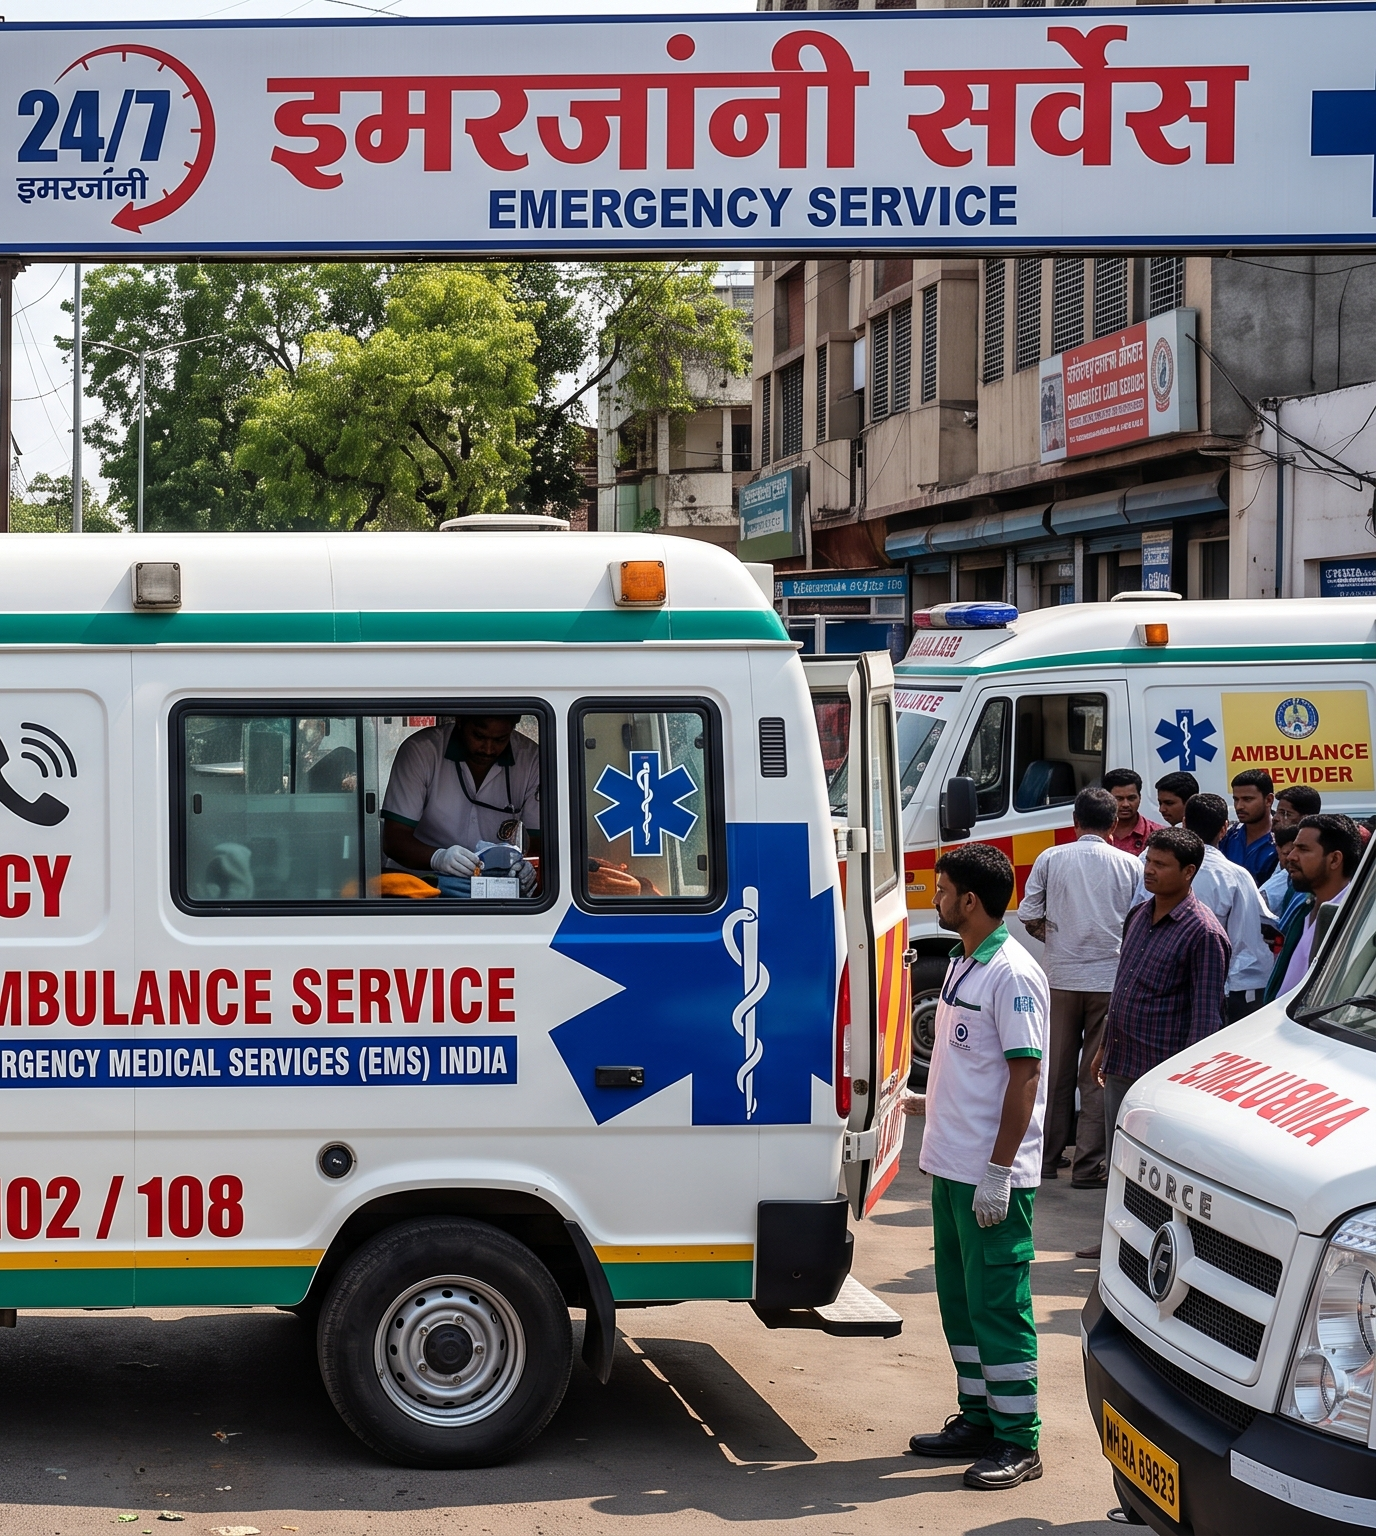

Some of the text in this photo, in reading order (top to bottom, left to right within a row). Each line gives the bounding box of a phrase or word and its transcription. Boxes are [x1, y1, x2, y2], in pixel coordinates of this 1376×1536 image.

[17, 88, 170, 163] 24/7
[489, 185, 1017, 230] EMERGENCY SERVICE
[1230, 743, 1369, 762] AMBULANCE
[1259, 766, 1354, 784] EVIDER
[291, 966, 516, 1025] SERVICE
[109, 1048, 221, 1078] MEDICAL
[229, 1046, 350, 1077] SERVICES
[358, 1046, 431, 1082] (EMS)
[440, 1046, 508, 1075] INDIA
[96, 1175, 124, 1240] /
[137, 1174, 244, 1239] 108
[1137, 1157, 1212, 1220] FORCE
